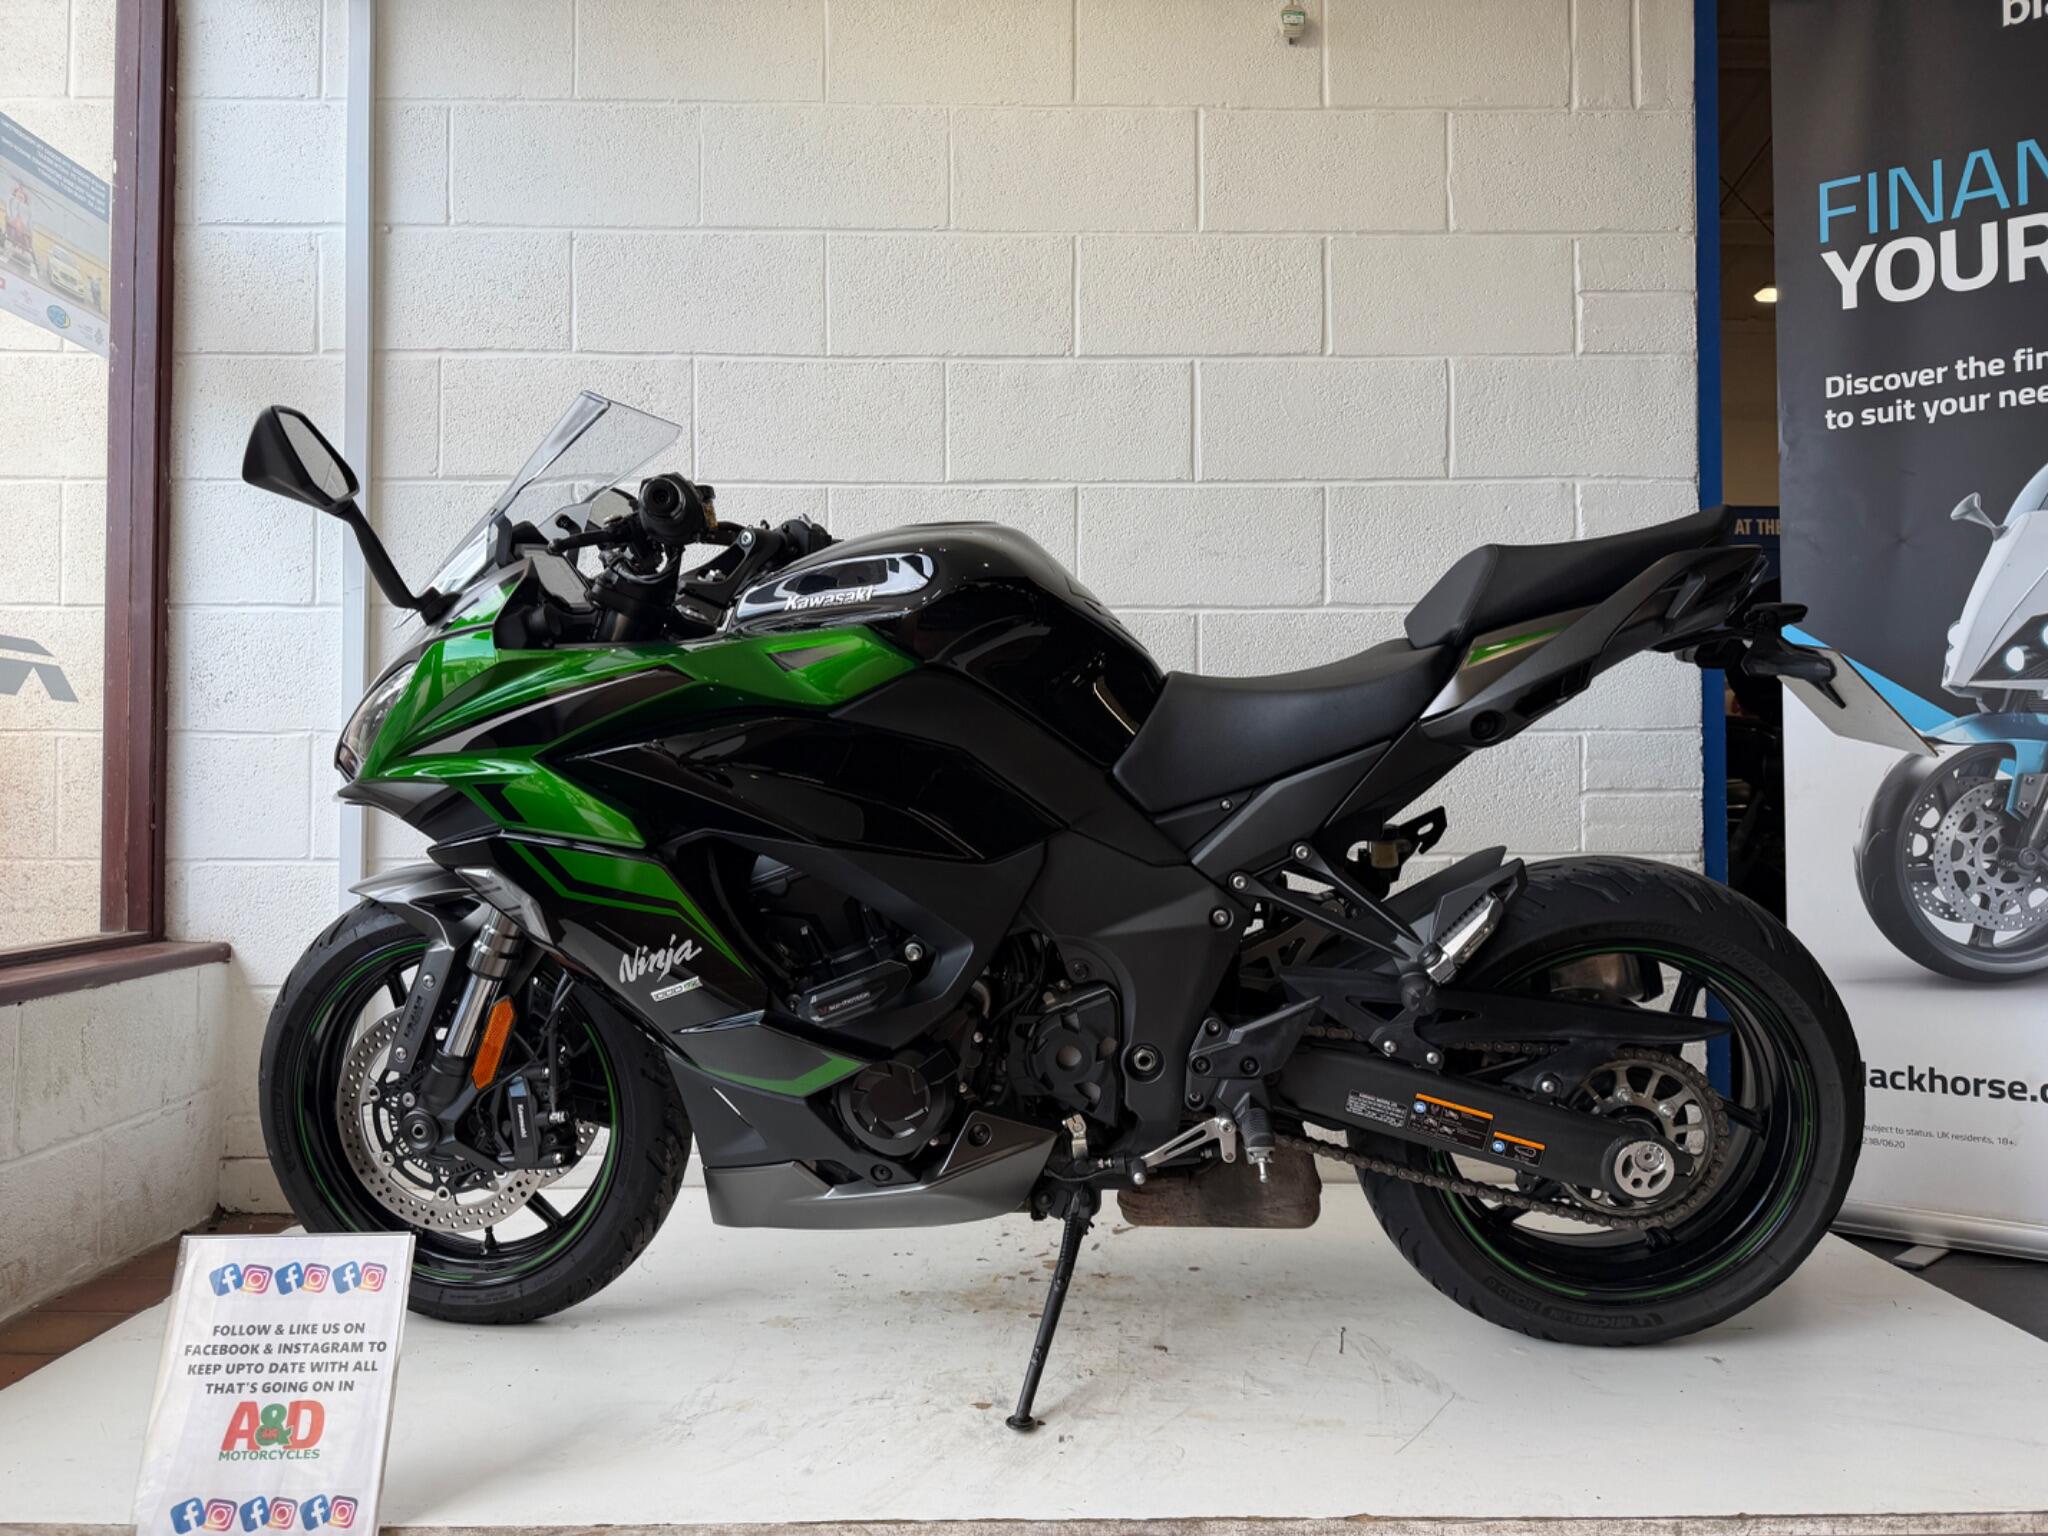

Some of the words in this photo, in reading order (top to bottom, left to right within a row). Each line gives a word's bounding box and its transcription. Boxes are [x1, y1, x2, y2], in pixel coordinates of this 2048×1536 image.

[2002, 0, 2048, 27] bl
[1820, 212, 2048, 310] YOUR
[1825, 365, 1948, 399] Discover
[1955, 356, 2005, 381] the
[1825, 409, 1854, 430] to
[1861, 398, 1916, 426] suit
[1922, 392, 1991, 424] your
[1734, 518, 1752, 535] AT
[784, 585, 874, 611] Kawasaki
[619, 934, 702, 983] Ninja
[1860, 1061, 2048, 1104] lackhorse.
[1895, 1126, 1905, 1135] to
[1937, 1131, 1950, 1139] UK
[212, 1324, 271, 1337] FOLLOW
[275, 1324, 285, 1335] &
[289, 1323, 318, 1335] LIKE
[322, 1323, 340, 1334] US
[343, 1322, 366, 1334] ON
[184, 1343, 260, 1356] FACEBOOK
[264, 1343, 273, 1354] &
[277, 1341, 364, 1354] INSTAGRAM
[368, 1341, 387, 1352] TO
[187, 1364, 222, 1376] KEEP
[225, 1362, 265, 1375] UPTO
[268, 1361, 306, 1374] DATE
[310, 1361, 349, 1373] WITH
[352, 1360, 379, 1372] ALL
[205, 1382, 258, 1394] THAT'S
[261, 1381, 308, 1394] GOING
[312, 1380, 335, 1392] ON
[338, 1380, 355, 1392] IN
[220, 1399, 326, 1451] A&D
[218, 1448, 321, 1461] MOTORCYCLES
